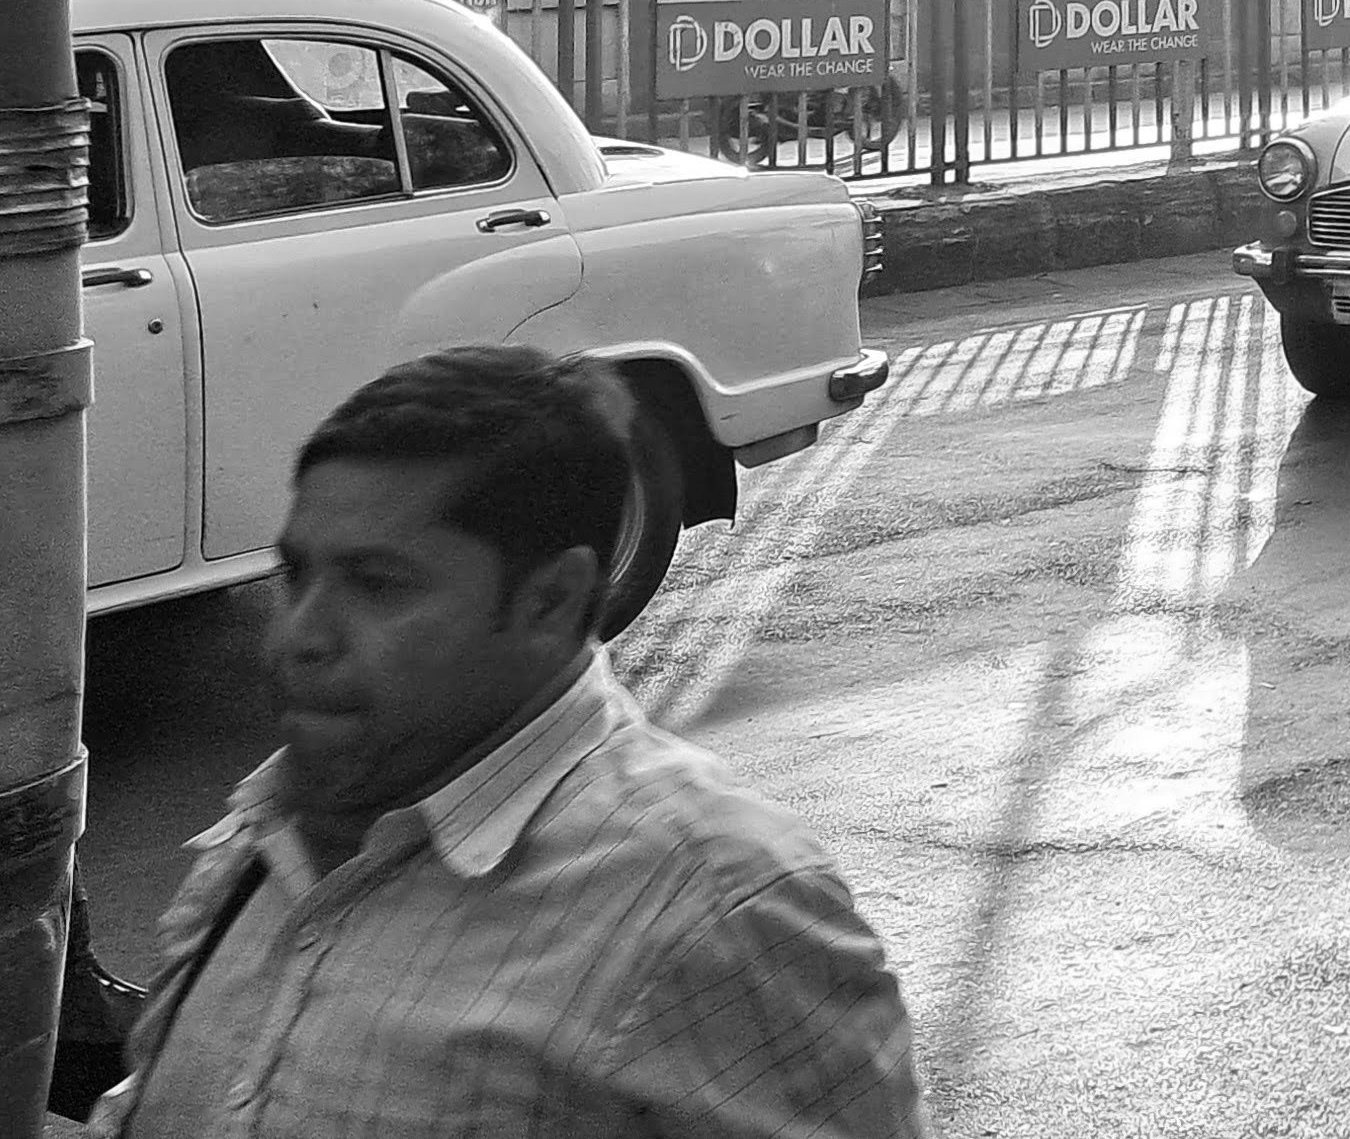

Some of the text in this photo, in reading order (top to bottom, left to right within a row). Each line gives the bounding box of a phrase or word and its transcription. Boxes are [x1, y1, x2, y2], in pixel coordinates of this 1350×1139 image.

[714, 16, 875, 62] DOLLAR
[1091, 34, 1198, 54] WEAR THE CHANGE
[744, 59, 874, 79] WEAR THE CHANGE
